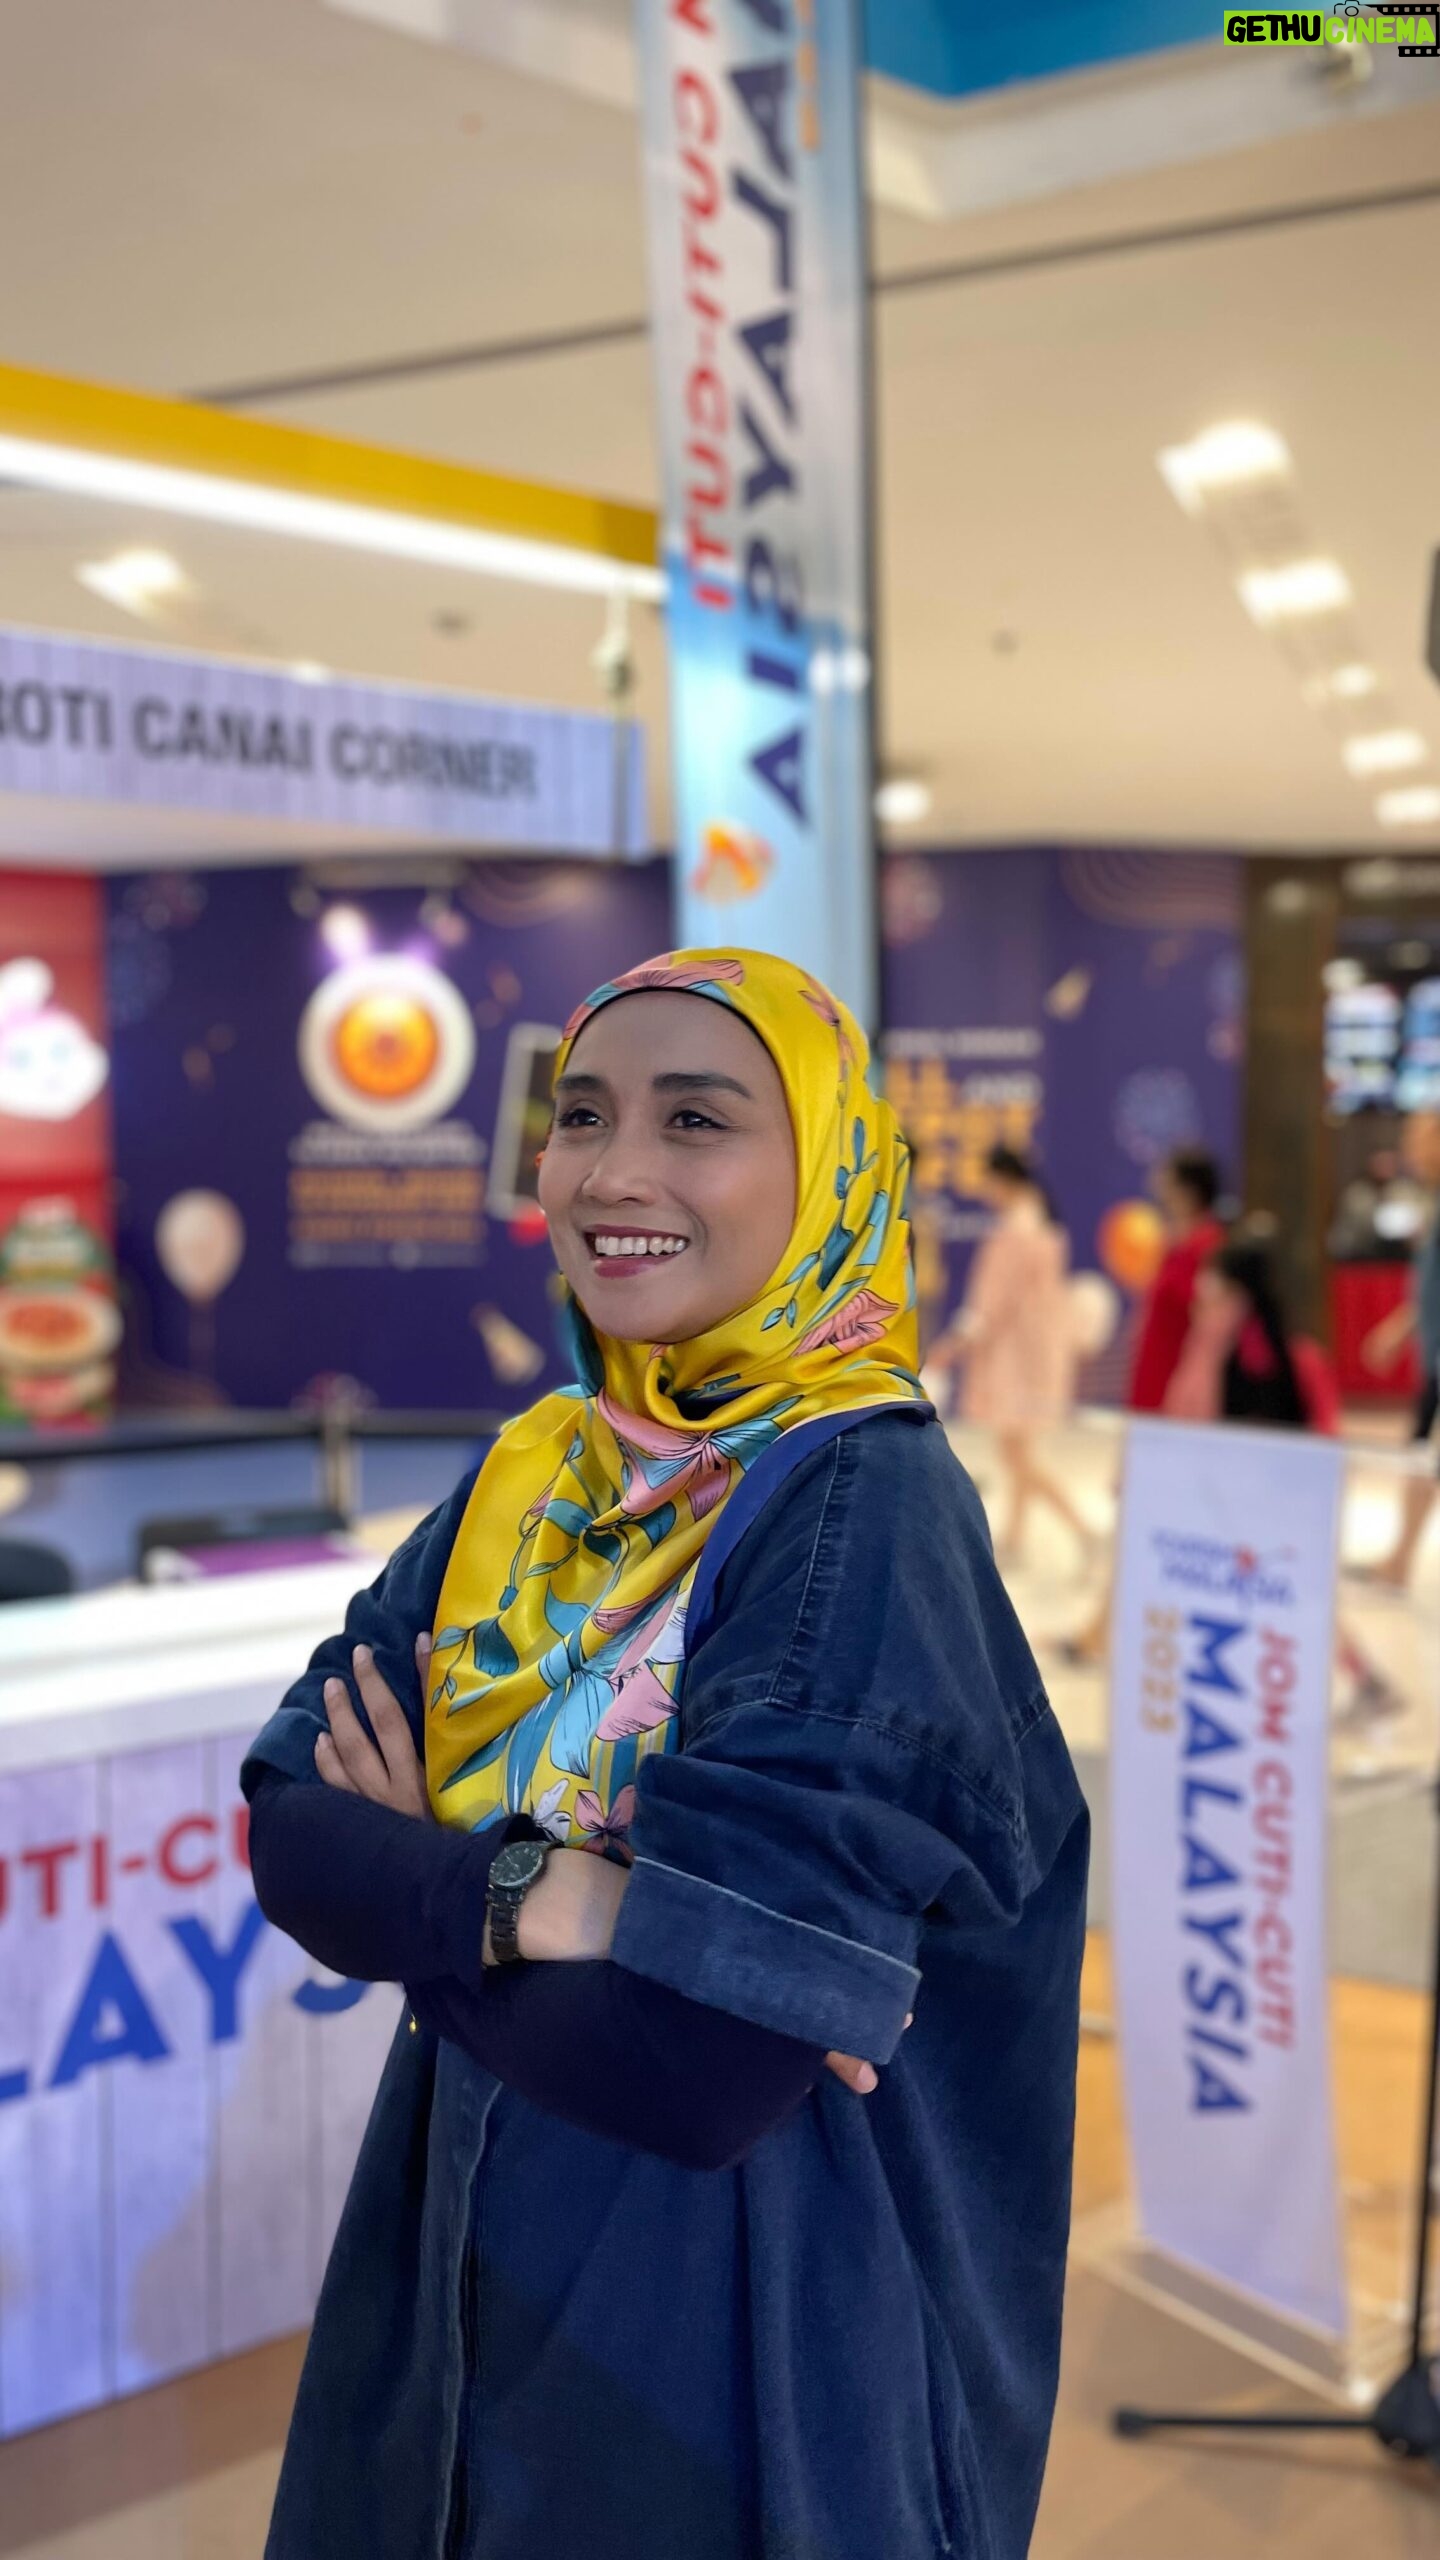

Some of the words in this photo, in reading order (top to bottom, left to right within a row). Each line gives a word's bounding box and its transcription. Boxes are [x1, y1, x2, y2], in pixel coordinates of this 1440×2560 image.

[0, 679, 113, 752] OTI
[132, 696, 314, 776] CANAI
[329, 716, 541, 798] CORNER
[1182, 1612, 1251, 2117] MALAYSIA
